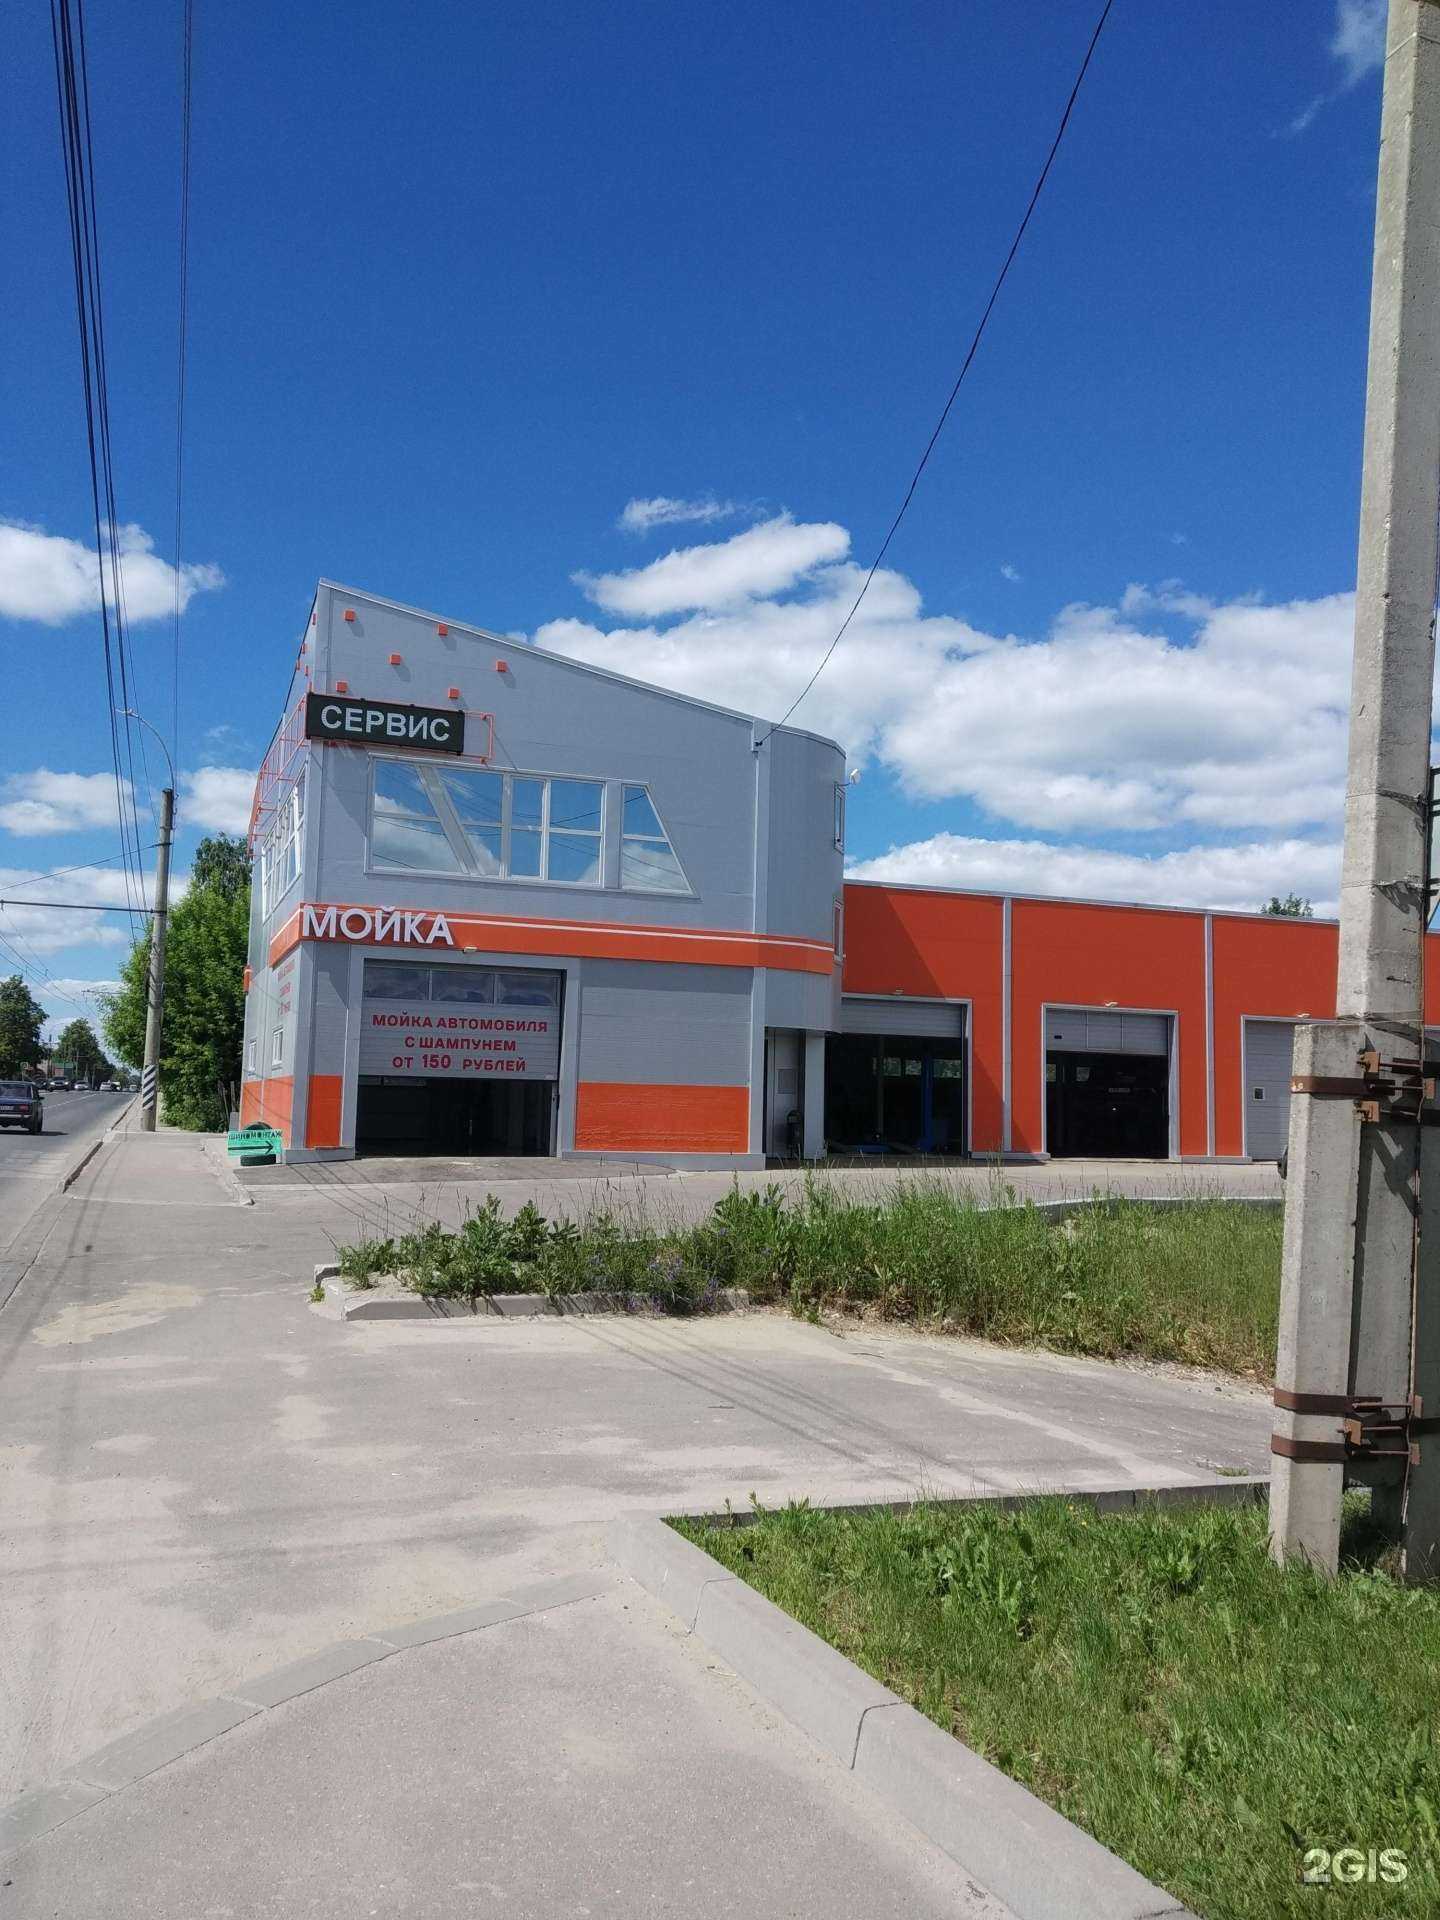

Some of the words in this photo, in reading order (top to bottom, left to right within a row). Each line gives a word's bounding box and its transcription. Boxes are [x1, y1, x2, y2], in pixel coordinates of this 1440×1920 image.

[321, 705, 450, 742] СЕРВИС
[302, 905, 454, 945] МОЙКА
[372, 1009, 433, 1028] МОЙКА
[436, 1017, 548, 1033] АВТОМОБИЛЯ
[404, 1036, 415, 1048] С
[419, 1037, 516, 1051] ШАМПУНЕМ
[392, 1056, 413, 1069] ОТ
[422, 1054, 451, 1069] 150
[462, 1057, 526, 1072] РУБЛЕЙ
